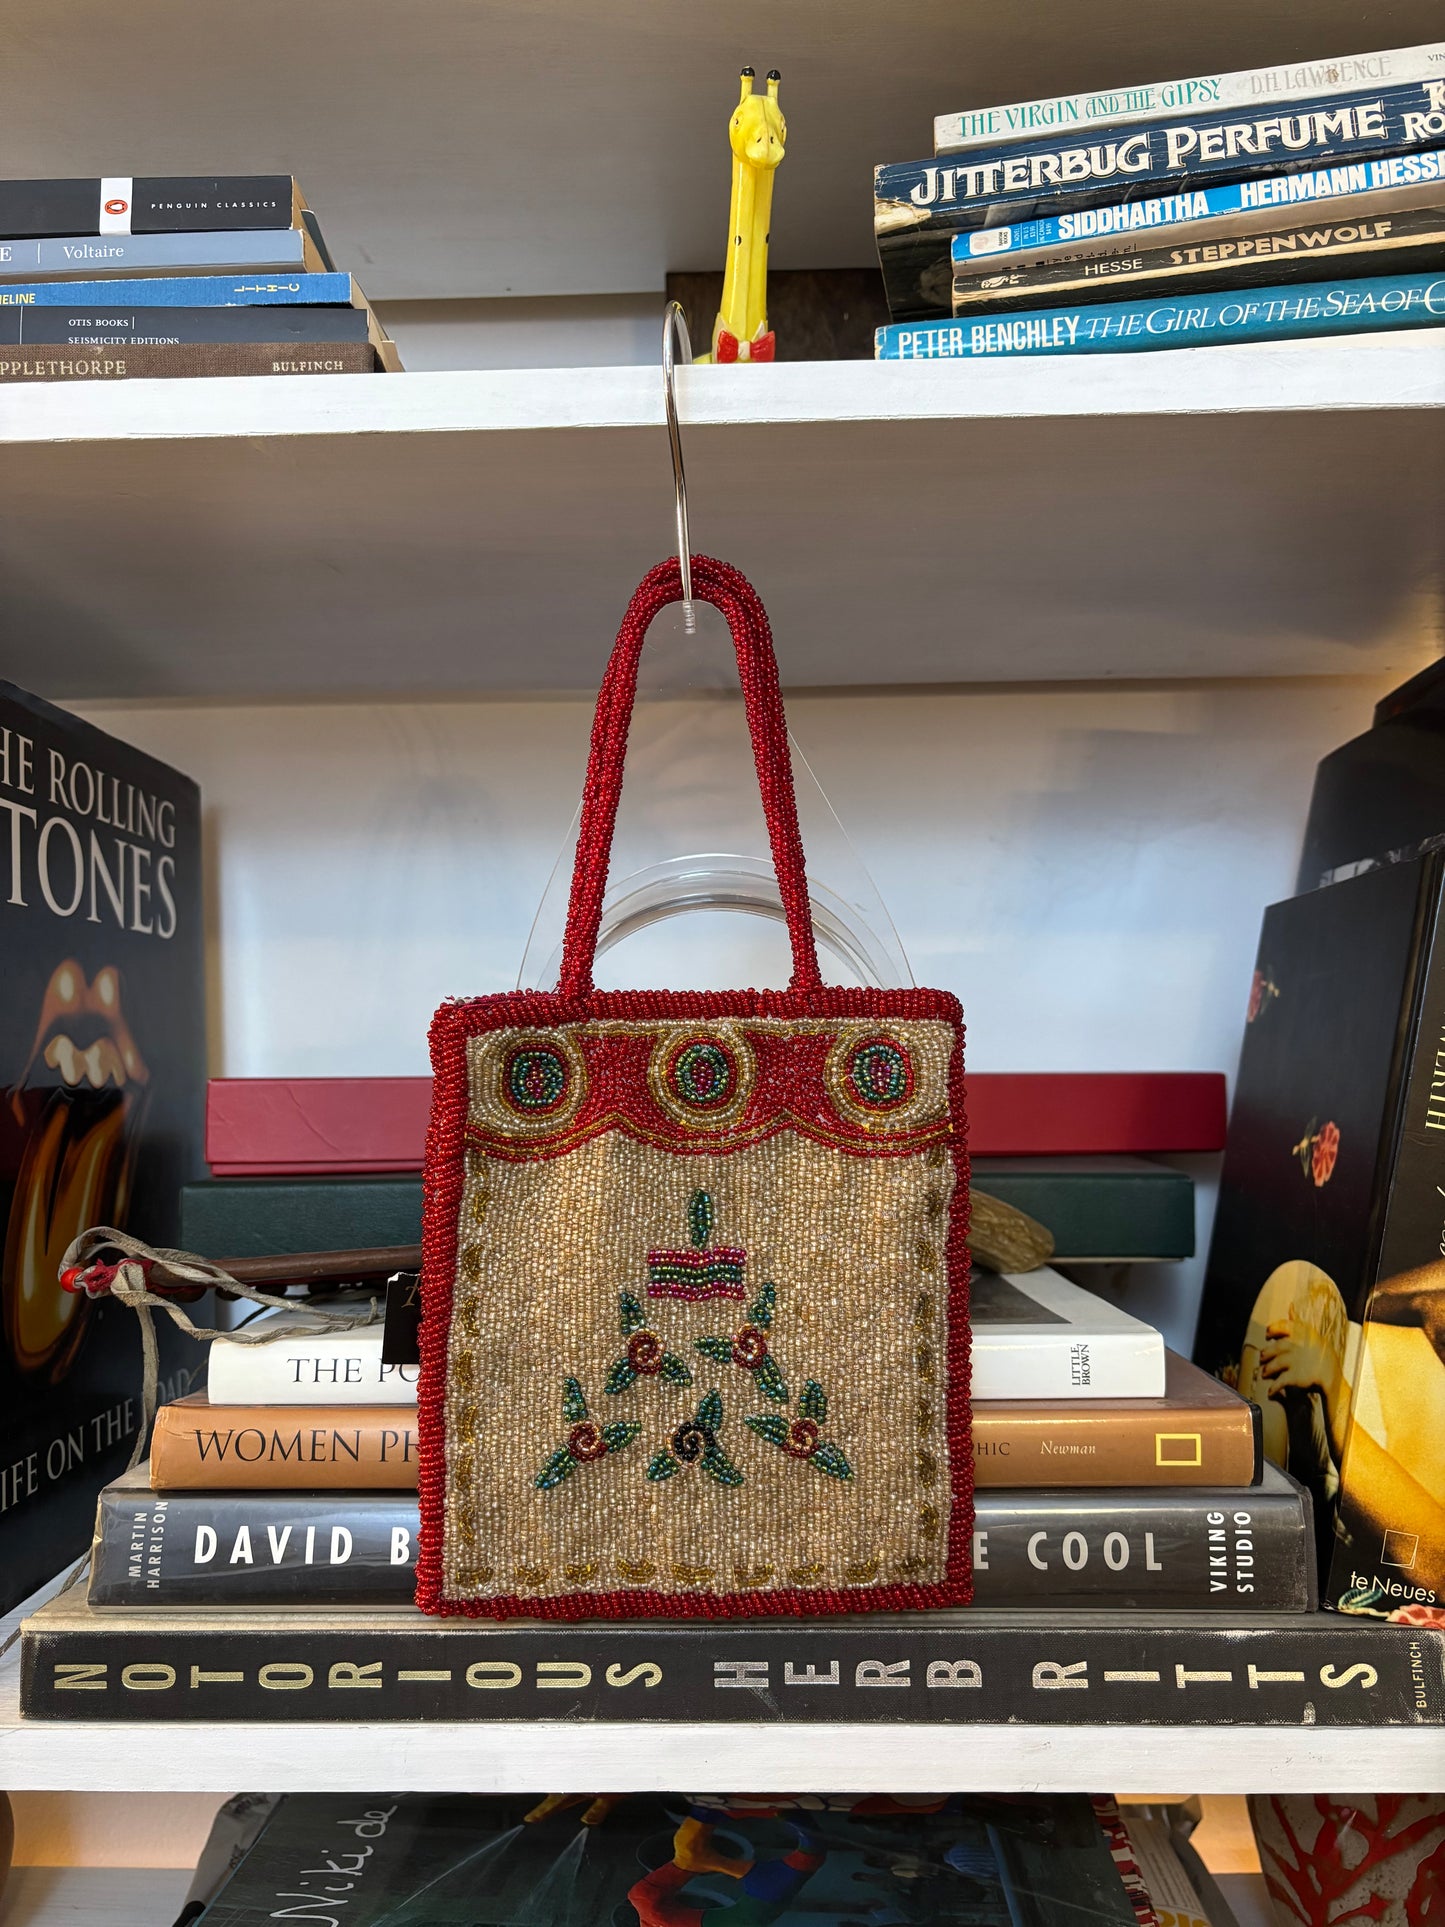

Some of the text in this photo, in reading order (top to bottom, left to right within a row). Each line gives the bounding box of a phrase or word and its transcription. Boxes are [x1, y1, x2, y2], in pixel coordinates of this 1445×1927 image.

[1285, 56, 1392, 90] LAWRENCE
[958, 77, 1222, 138] THE VIRGIN AND THE GIPSY
[909, 99, 1388, 206] JITTERBUG PERFUME
[1240, 163, 1367, 209] HERMANN
[1058, 191, 1210, 240] SIDDHARTHA
[63, 244, 125, 259] Voltaire
[1168, 220, 1393, 265] STEPPENWOLF
[234, 283, 300, 293] LITHIC
[1085, 258, 1143, 277] HESSE
[68, 319, 129, 327] OTIS BOOKS
[1086, 313, 1144, 339] THE
[1145, 307, 1217, 334] GIRL
[1218, 302, 1260, 326] OF
[1262, 297, 1321, 322] THE
[1323, 290, 1377, 317] SEA
[1381, 288, 1423, 312] OF
[68, 337, 180, 345] SEISMICITY EDITIONS
[899, 316, 1080, 360] PETER BENCHLEY
[0, 360, 126, 376] PPLETHORPE
[272, 361, 344, 372] BULFINCH
[48, 747, 176, 848] ROLLING
[0, 797, 177, 940] TONES
[287, 1358, 363, 1383] THE
[1080, 1344, 1090, 1386] BROWN
[46, 1425, 84, 1480] ON
[91, 1398, 135, 1453] THE
[193, 1429, 362, 1463] WOMEN
[977, 1442, 1011, 1456] HIC
[1040, 1440, 1097, 1456] Newman
[128, 1511, 148, 1578] MARTIN
[147, 1501, 168, 1589] HARRISON
[194, 1525, 411, 1565] DAVID B
[1027, 1531, 1163, 1571] COOL
[1206, 1511, 1228, 1593] VIKING
[1233, 1511, 1254, 1594] STUDIO
[54, 1660, 1379, 1691] NOTORIOUS HERB RITTS
[1408, 1641, 1428, 1710] BULFINCH
[336, 1805, 398, 1838] de
